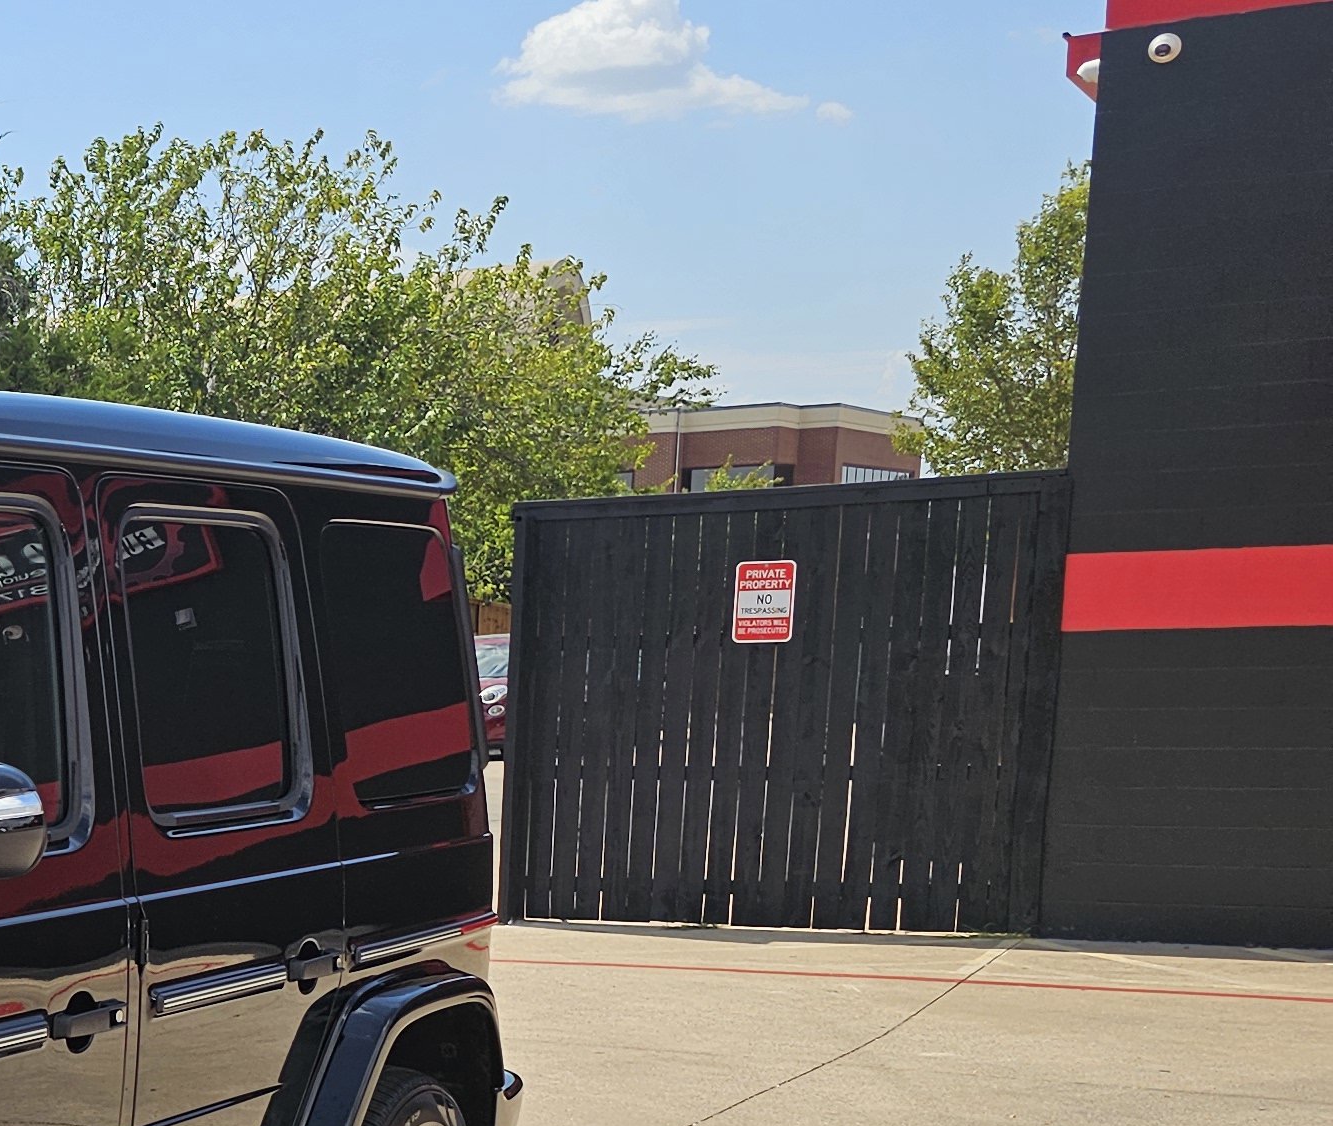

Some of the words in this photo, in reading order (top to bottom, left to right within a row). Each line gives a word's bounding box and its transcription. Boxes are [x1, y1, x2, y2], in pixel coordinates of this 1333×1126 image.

[746, 569, 787, 579] PRIVATE
[739, 579, 792, 589] PROPERTY
[756, 594, 773, 605] NO
[737, 627, 746, 635] BE
